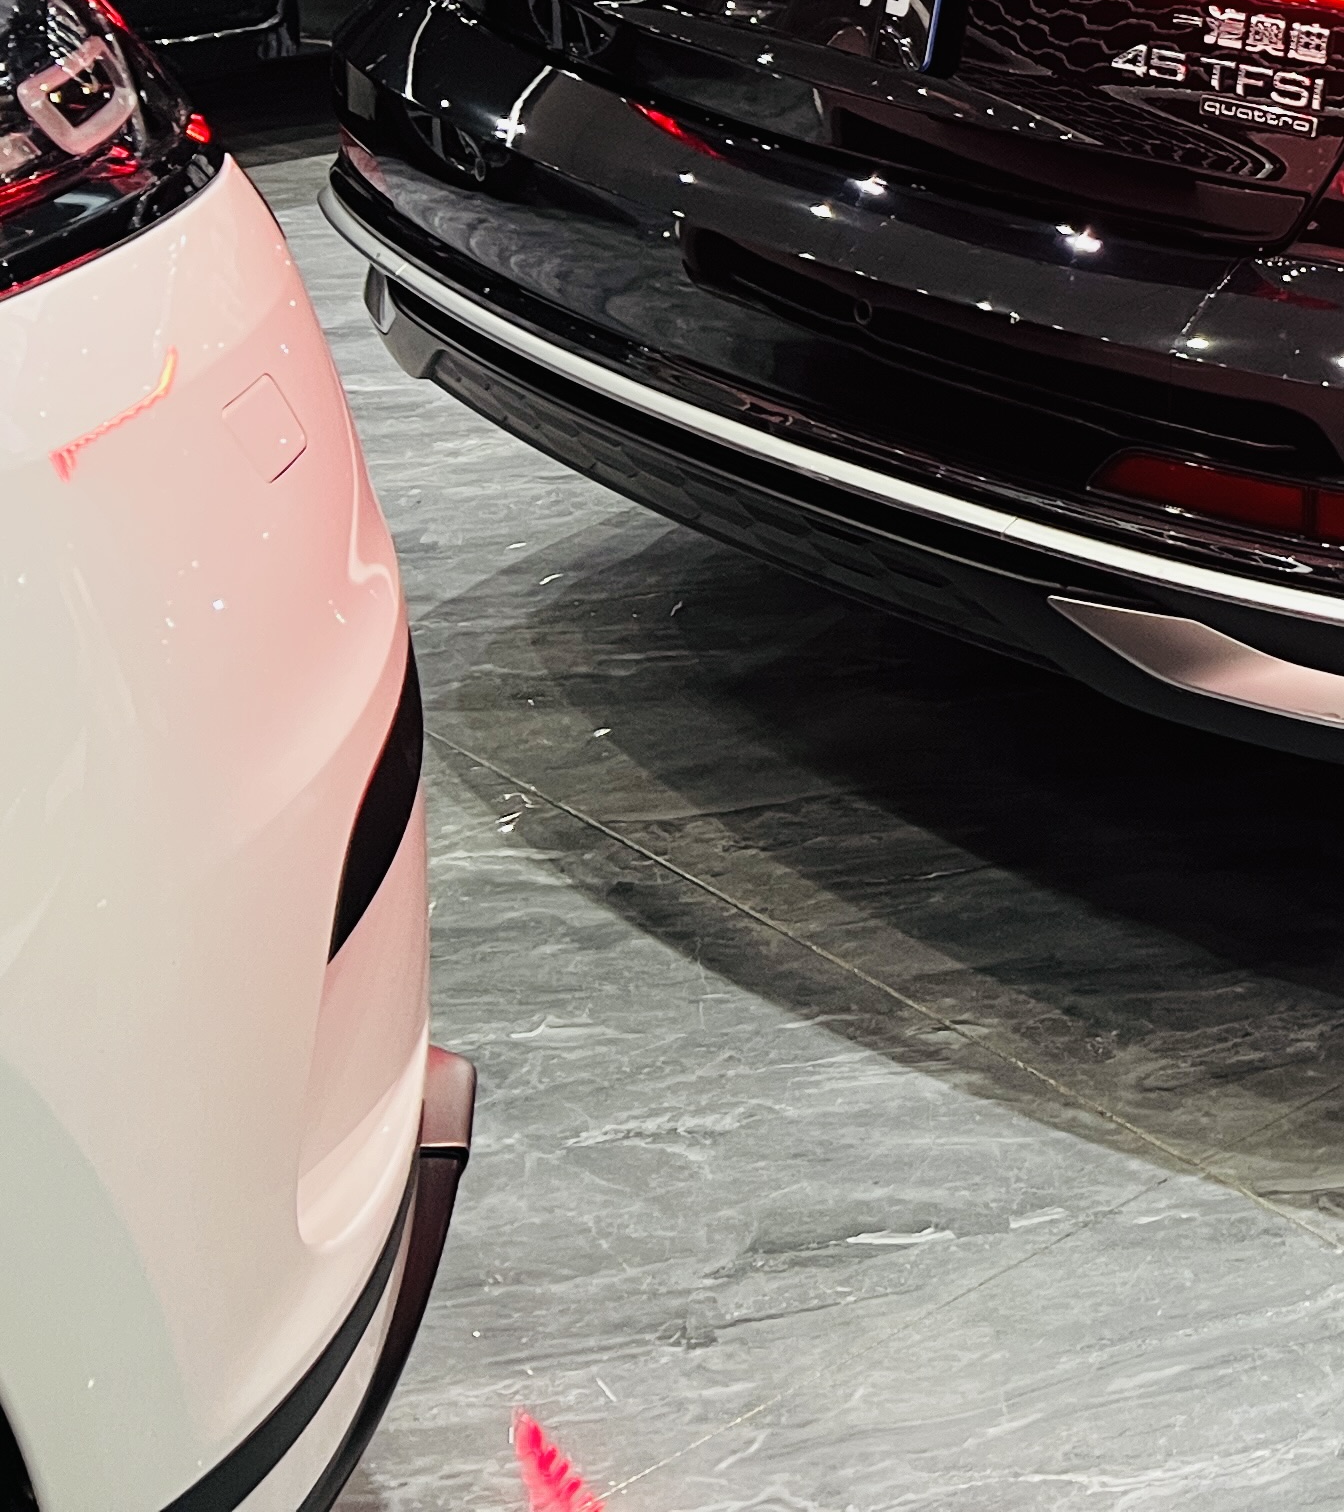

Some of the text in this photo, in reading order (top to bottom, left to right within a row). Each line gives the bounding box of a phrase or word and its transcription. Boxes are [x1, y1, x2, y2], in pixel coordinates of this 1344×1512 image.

[1111, 43, 1325, 112] 45 TFSI
[1202, 97, 1311, 133] quattro
